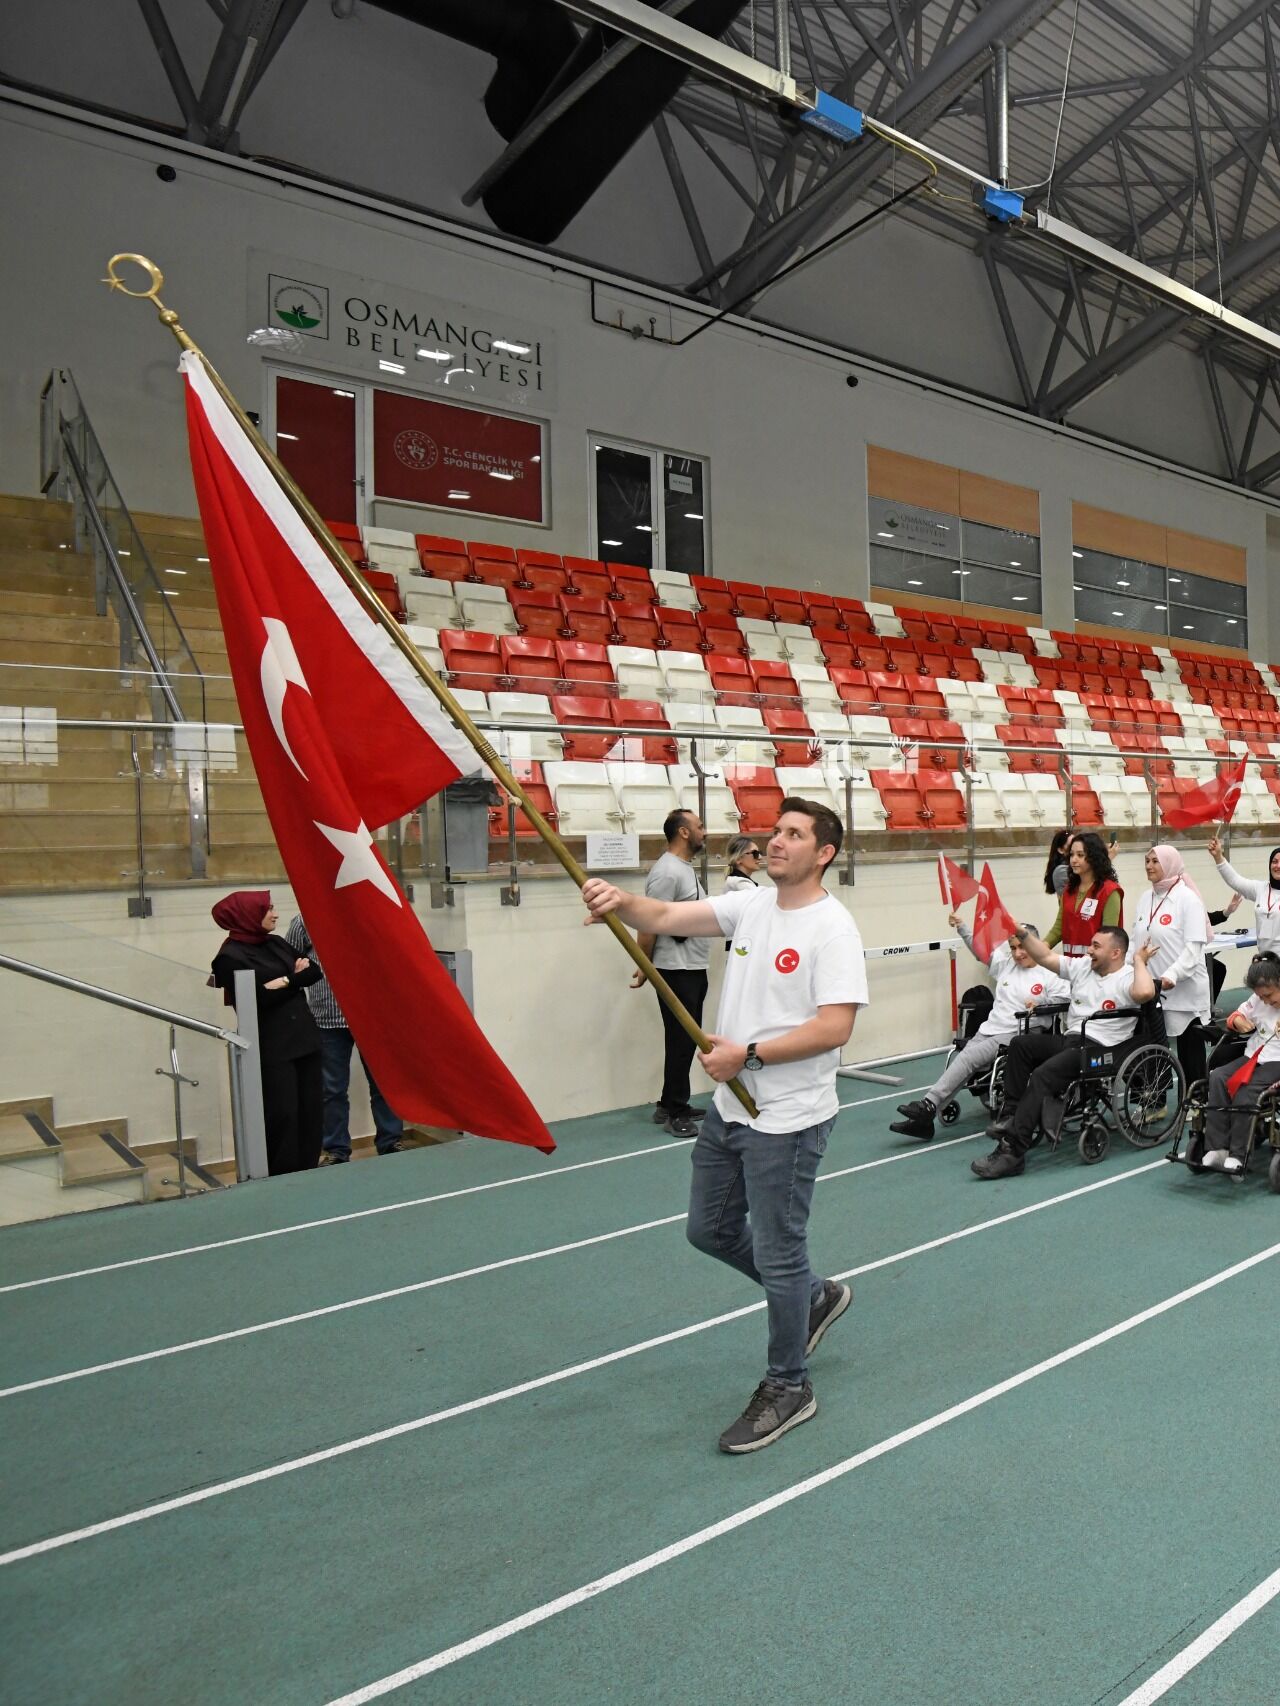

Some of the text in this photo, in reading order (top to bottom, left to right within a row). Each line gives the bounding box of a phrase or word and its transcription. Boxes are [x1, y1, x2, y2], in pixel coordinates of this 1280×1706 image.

[443, 457, 470, 469] SPOR
[511, 459, 524, 469] VE
[883, 946, 910, 956] CROWN
